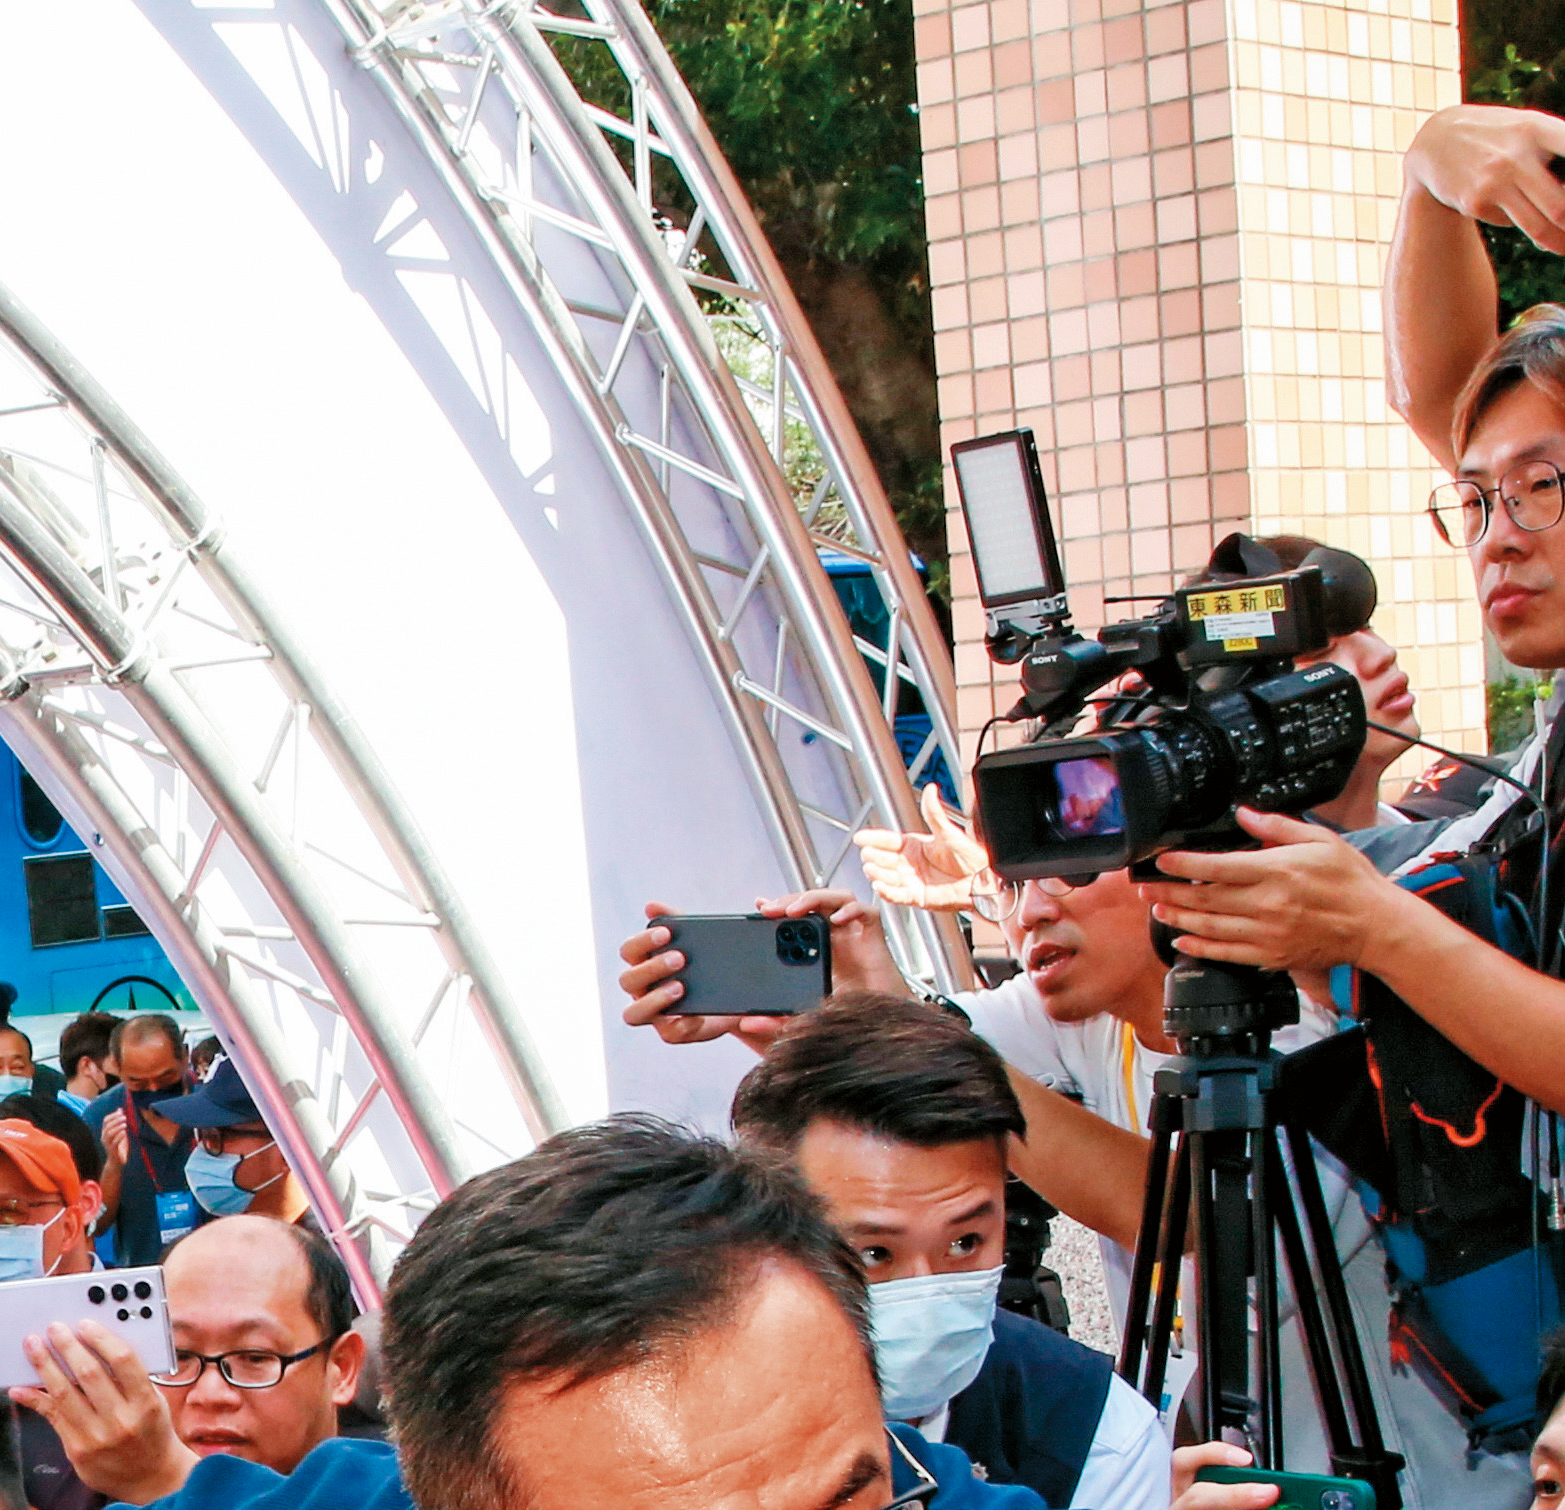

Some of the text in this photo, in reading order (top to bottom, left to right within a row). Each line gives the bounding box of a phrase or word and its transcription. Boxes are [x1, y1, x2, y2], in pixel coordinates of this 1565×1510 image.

[1188, 587, 1285, 617] 東森新聞
[1031, 653, 1058, 665] SONY
[1303, 666, 1336, 684] SONY
